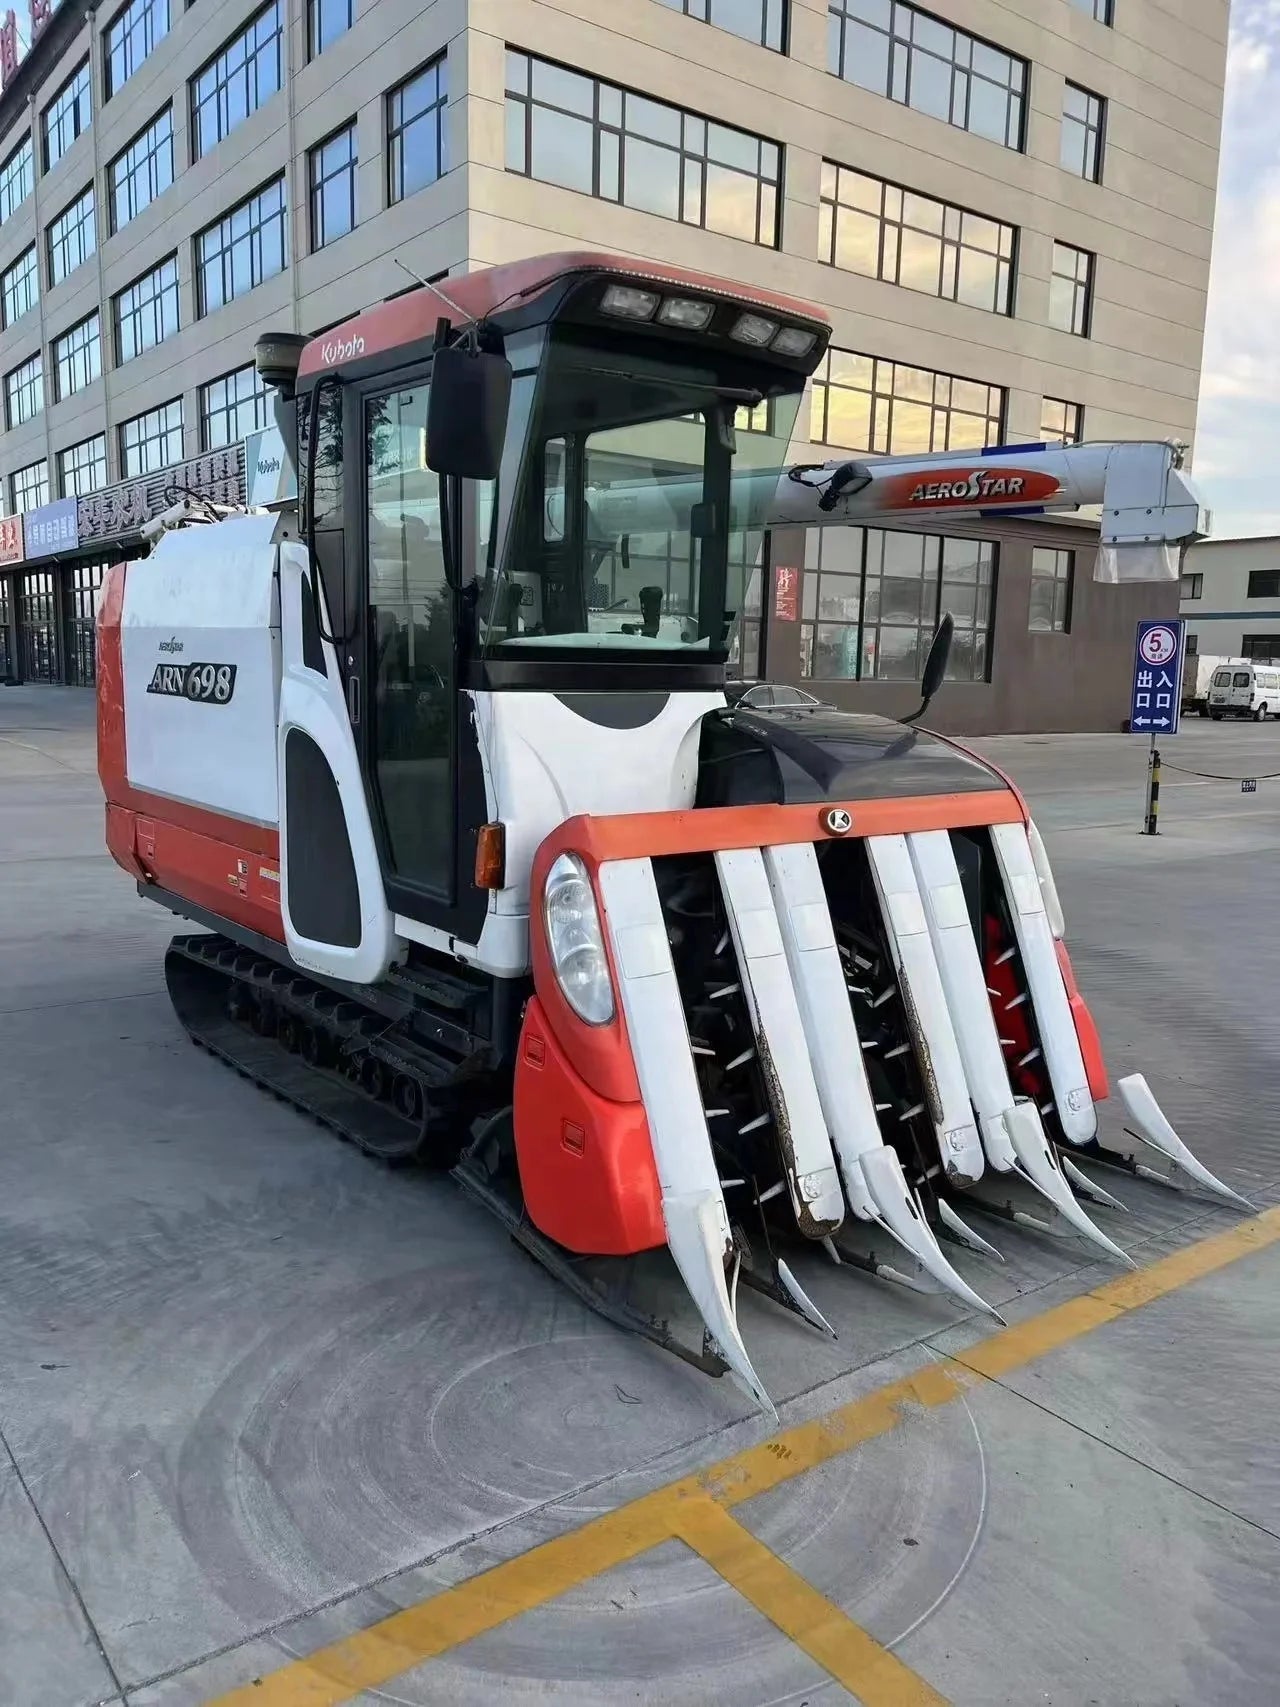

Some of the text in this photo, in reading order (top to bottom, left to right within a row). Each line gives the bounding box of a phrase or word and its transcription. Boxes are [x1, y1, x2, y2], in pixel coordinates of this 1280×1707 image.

[321, 333, 365, 364] Kubota
[909, 471, 1023, 500] AEROSTAR
[1149, 633, 1162, 653] 5
